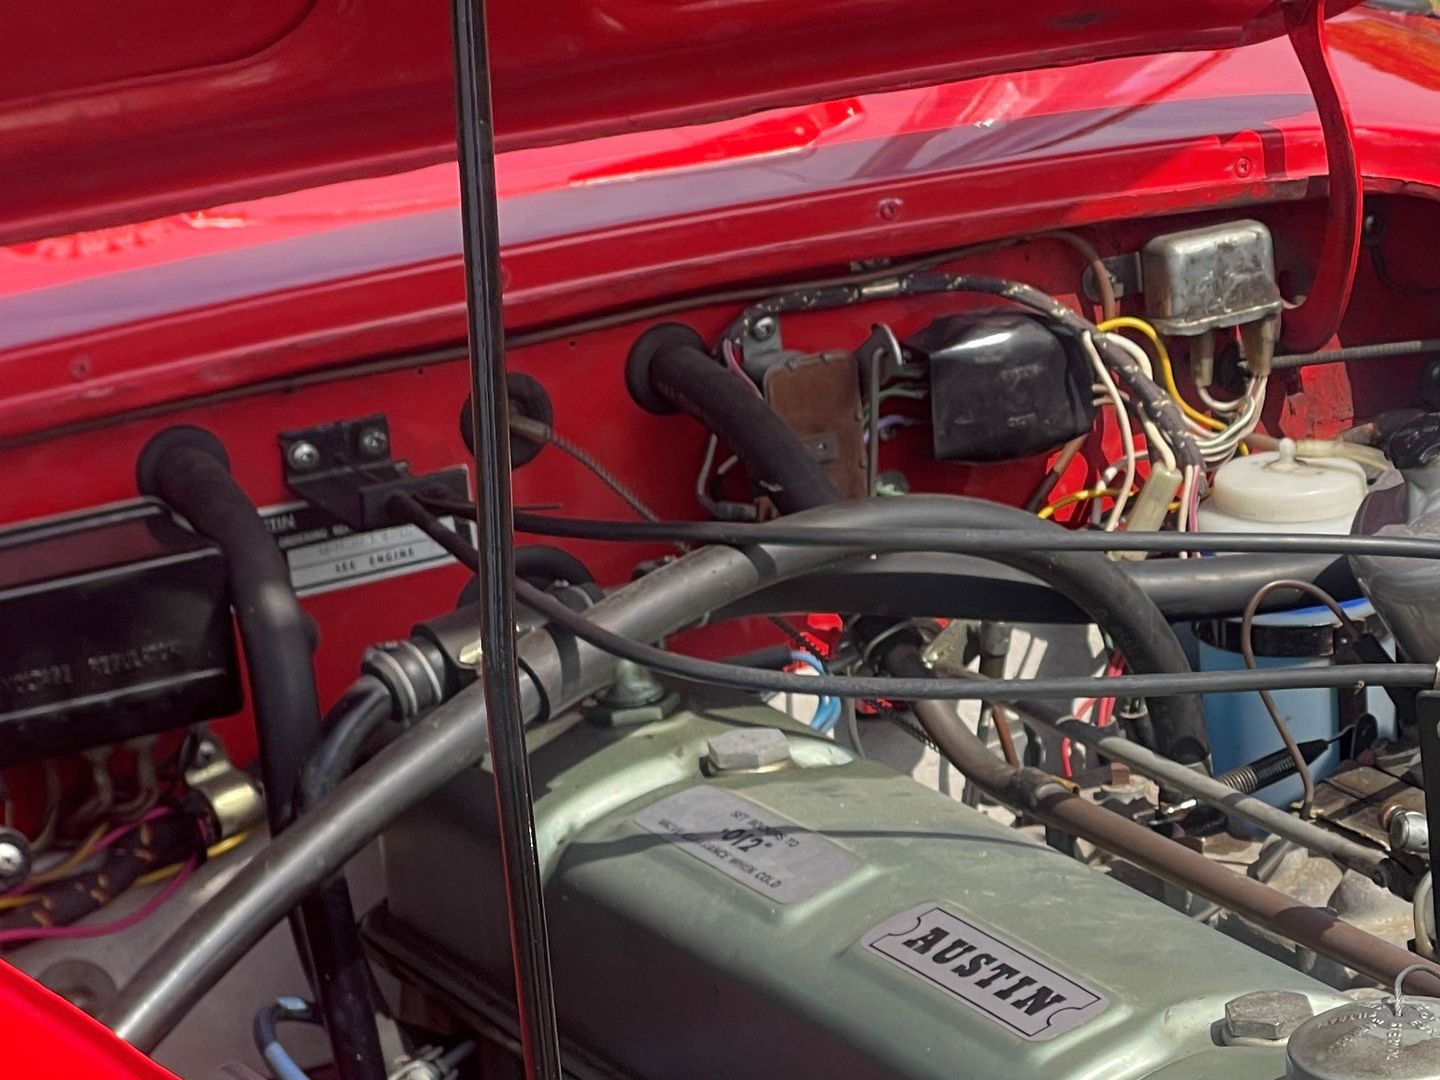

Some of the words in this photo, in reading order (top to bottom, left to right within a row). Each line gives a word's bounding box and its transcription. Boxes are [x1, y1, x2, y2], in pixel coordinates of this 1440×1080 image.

[369, 547, 415, 567] ENGINE
[755, 872, 782, 889] COLD
[902, 917, 1067, 1007] AUSTIN
